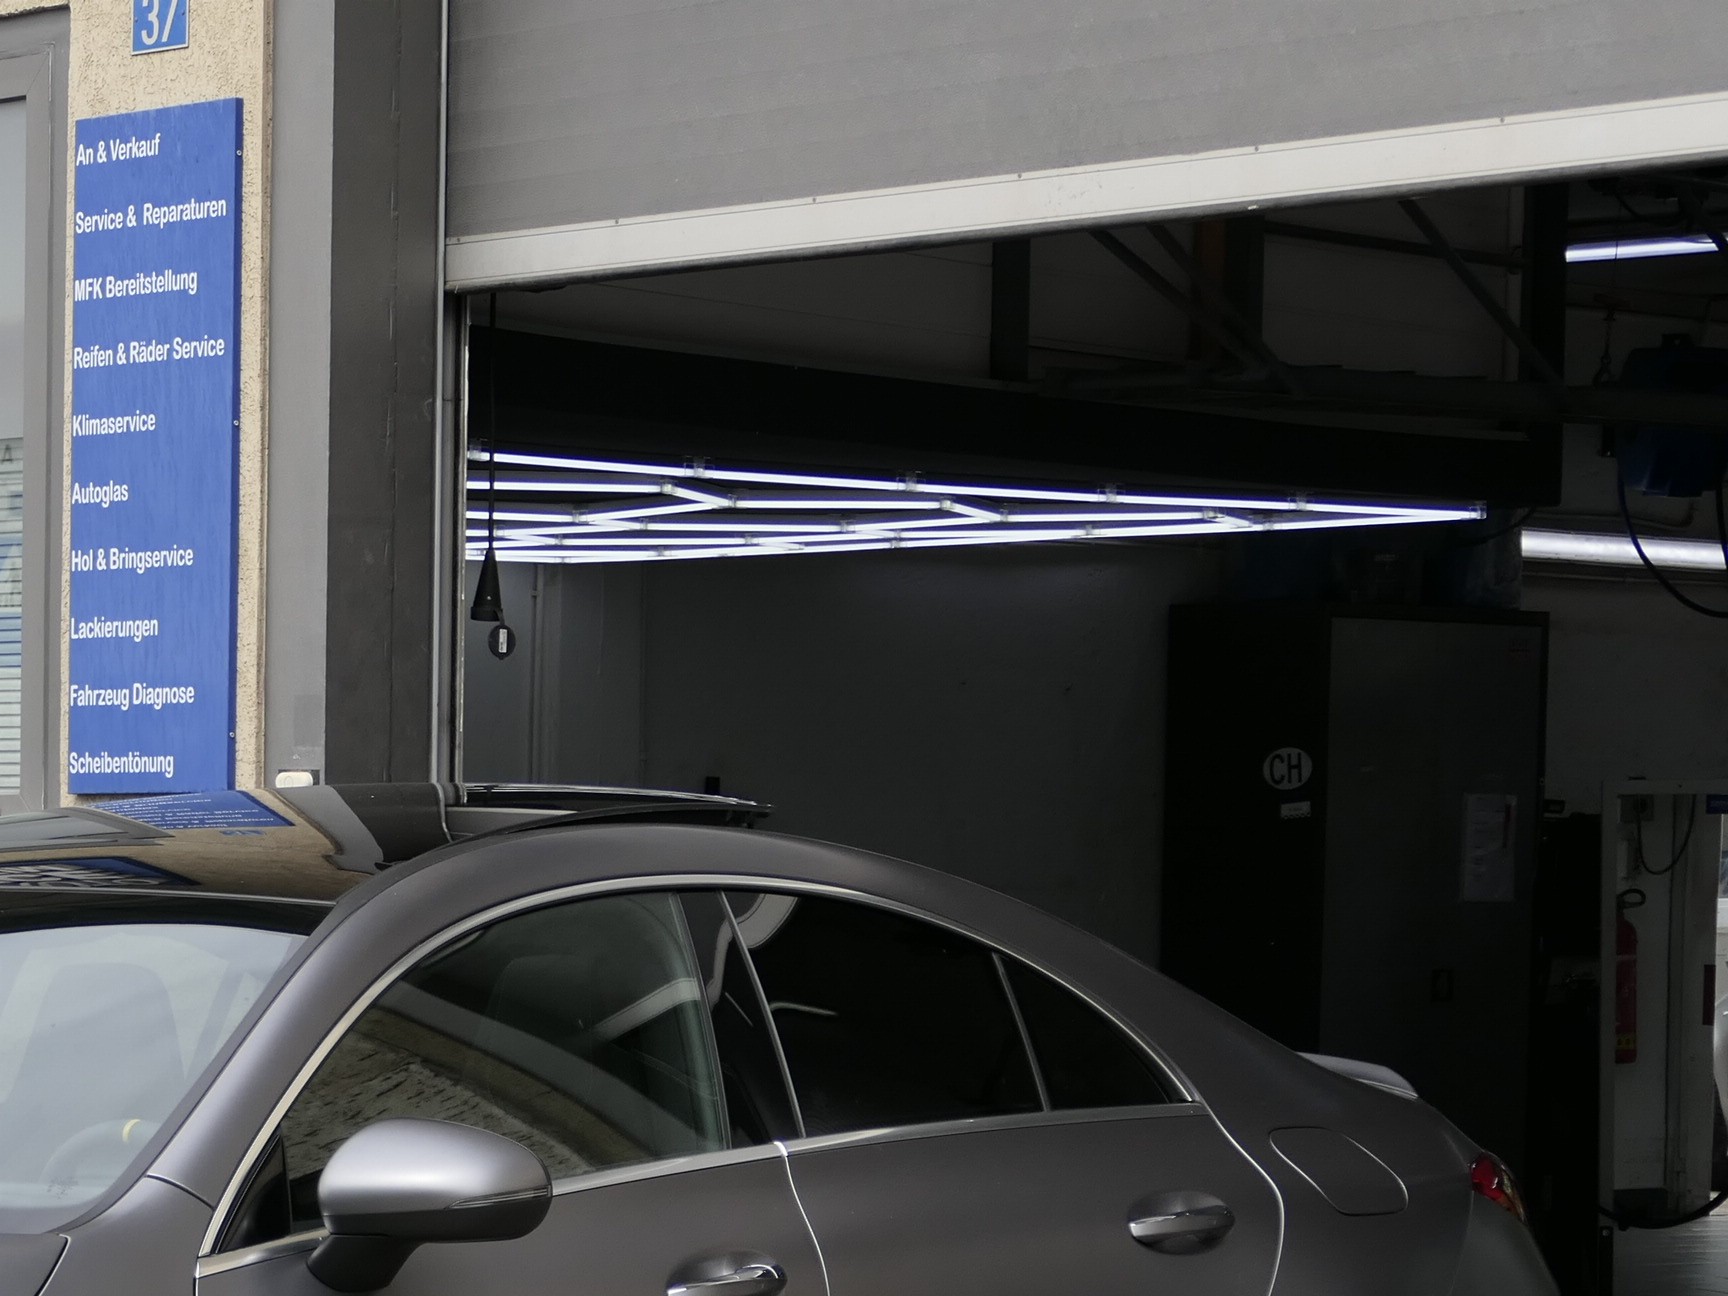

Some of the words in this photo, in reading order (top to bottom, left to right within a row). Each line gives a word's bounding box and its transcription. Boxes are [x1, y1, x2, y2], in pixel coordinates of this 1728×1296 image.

[76, 144, 93, 166] An
[97, 141, 107, 163] &
[110, 133, 160, 160] Verkauf
[76, 209, 123, 233] Service
[127, 205, 136, 227] &
[143, 199, 226, 228] Reparaturen
[75, 278, 102, 301] MFK
[106, 270, 197, 297] Bereitstellung
[74, 345, 113, 369] Reifen
[117, 343, 126, 364] &
[130, 337, 170, 363] Räder
[173, 335, 224, 359] Service
[73, 410, 155, 436] Klimaservice
[72, 480, 128, 507] Autoglas
[72, 549, 92, 571] Hol
[97, 549, 106, 570] &
[110, 545, 193, 574] Bringservice
[71, 617, 158, 642] Lackierungen
[70, 685, 129, 710] Fahrzeug
[133, 683, 194, 709] Diagnose
[70, 750, 174, 778] Scheibentönung
[1270, 752, 1302, 785] CH
